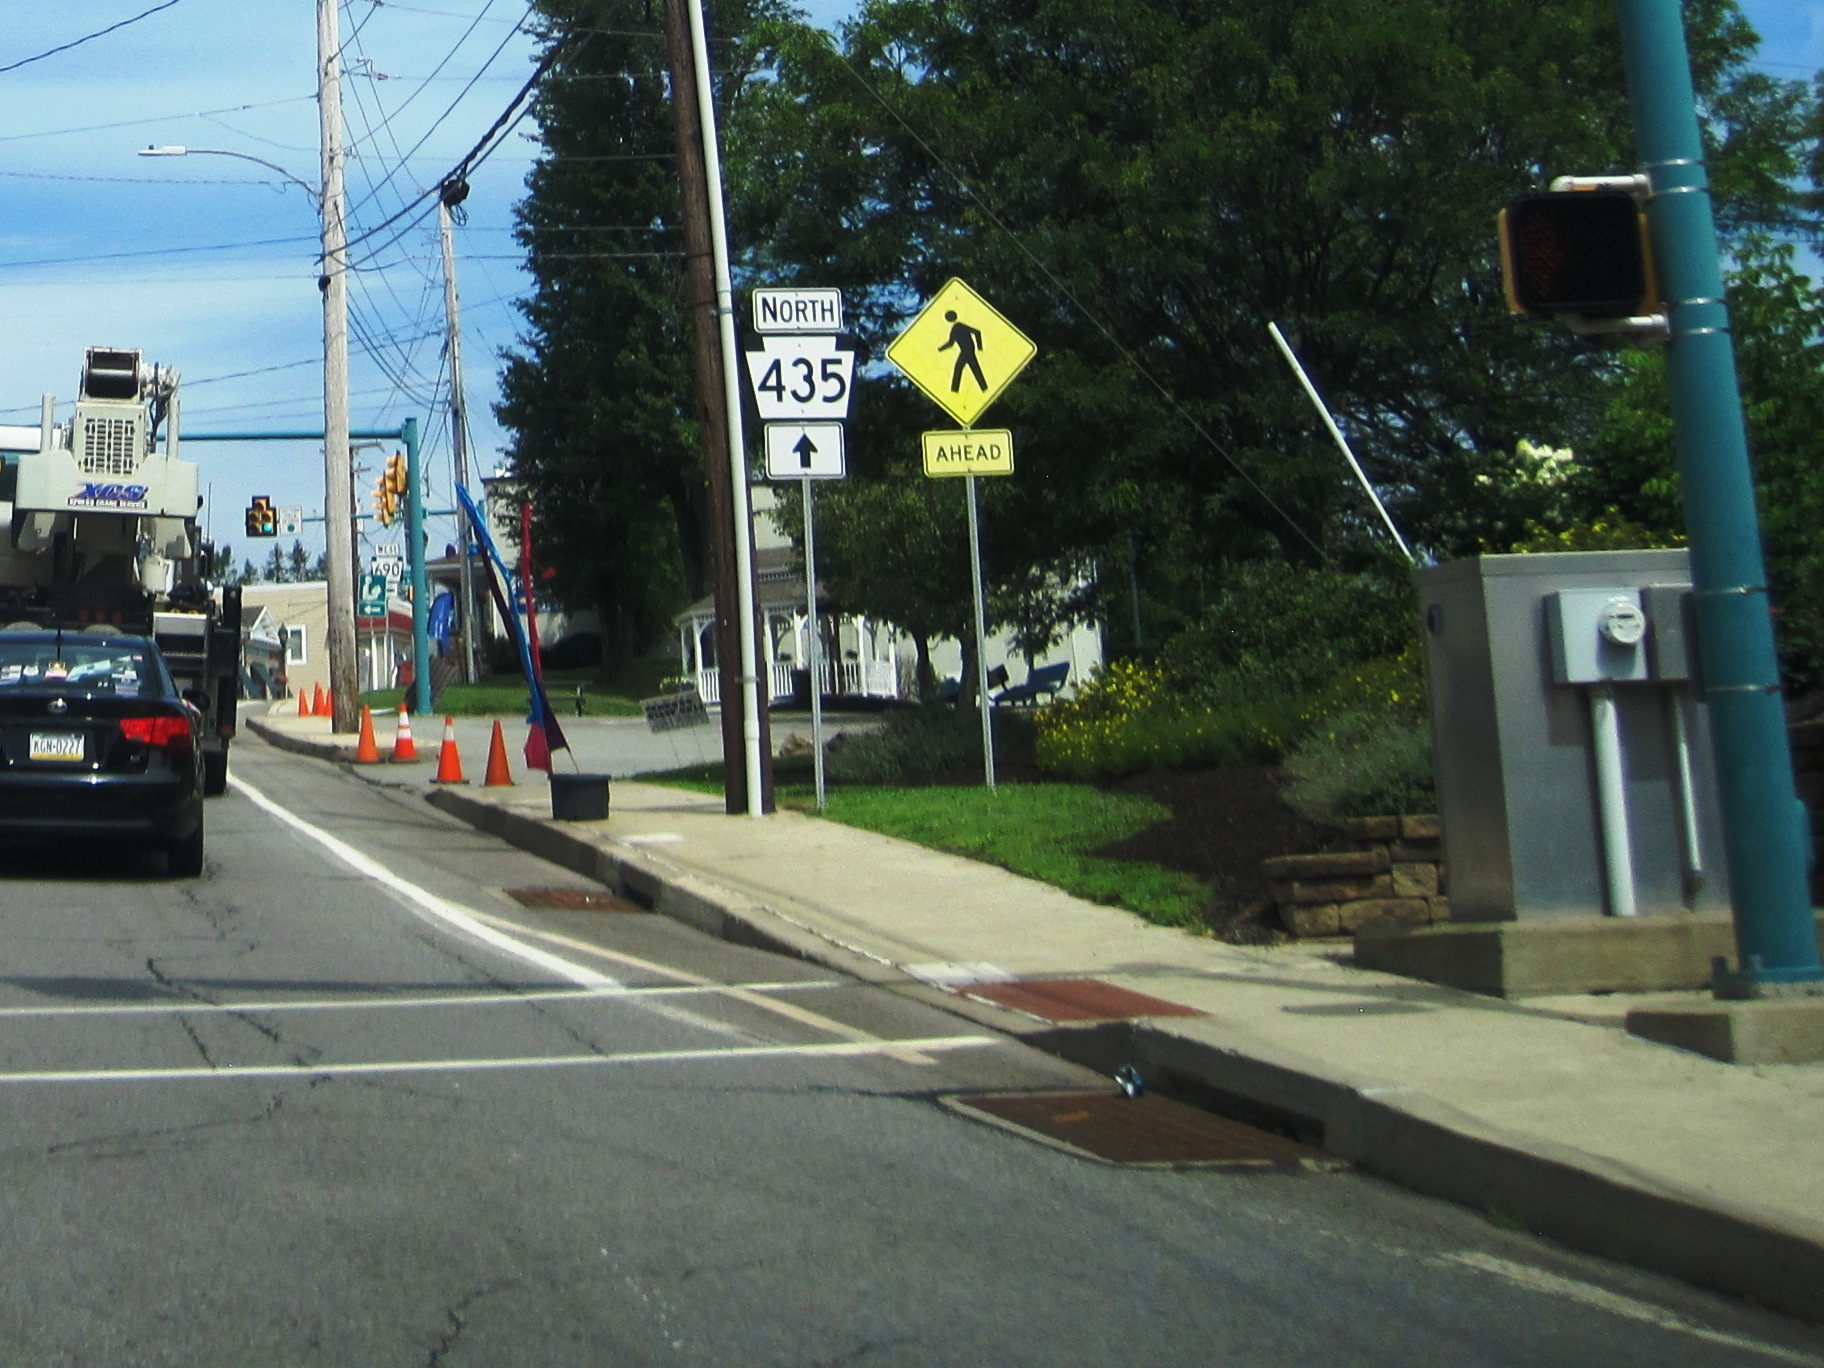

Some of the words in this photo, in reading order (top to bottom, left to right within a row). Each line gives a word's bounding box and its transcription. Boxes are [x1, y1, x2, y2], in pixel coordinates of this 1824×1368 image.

[761, 296, 834, 324] NORTH
[757, 357, 847, 403] 435
[936, 443, 1002, 462] AHEAD
[374, 563, 400, 577] 690
